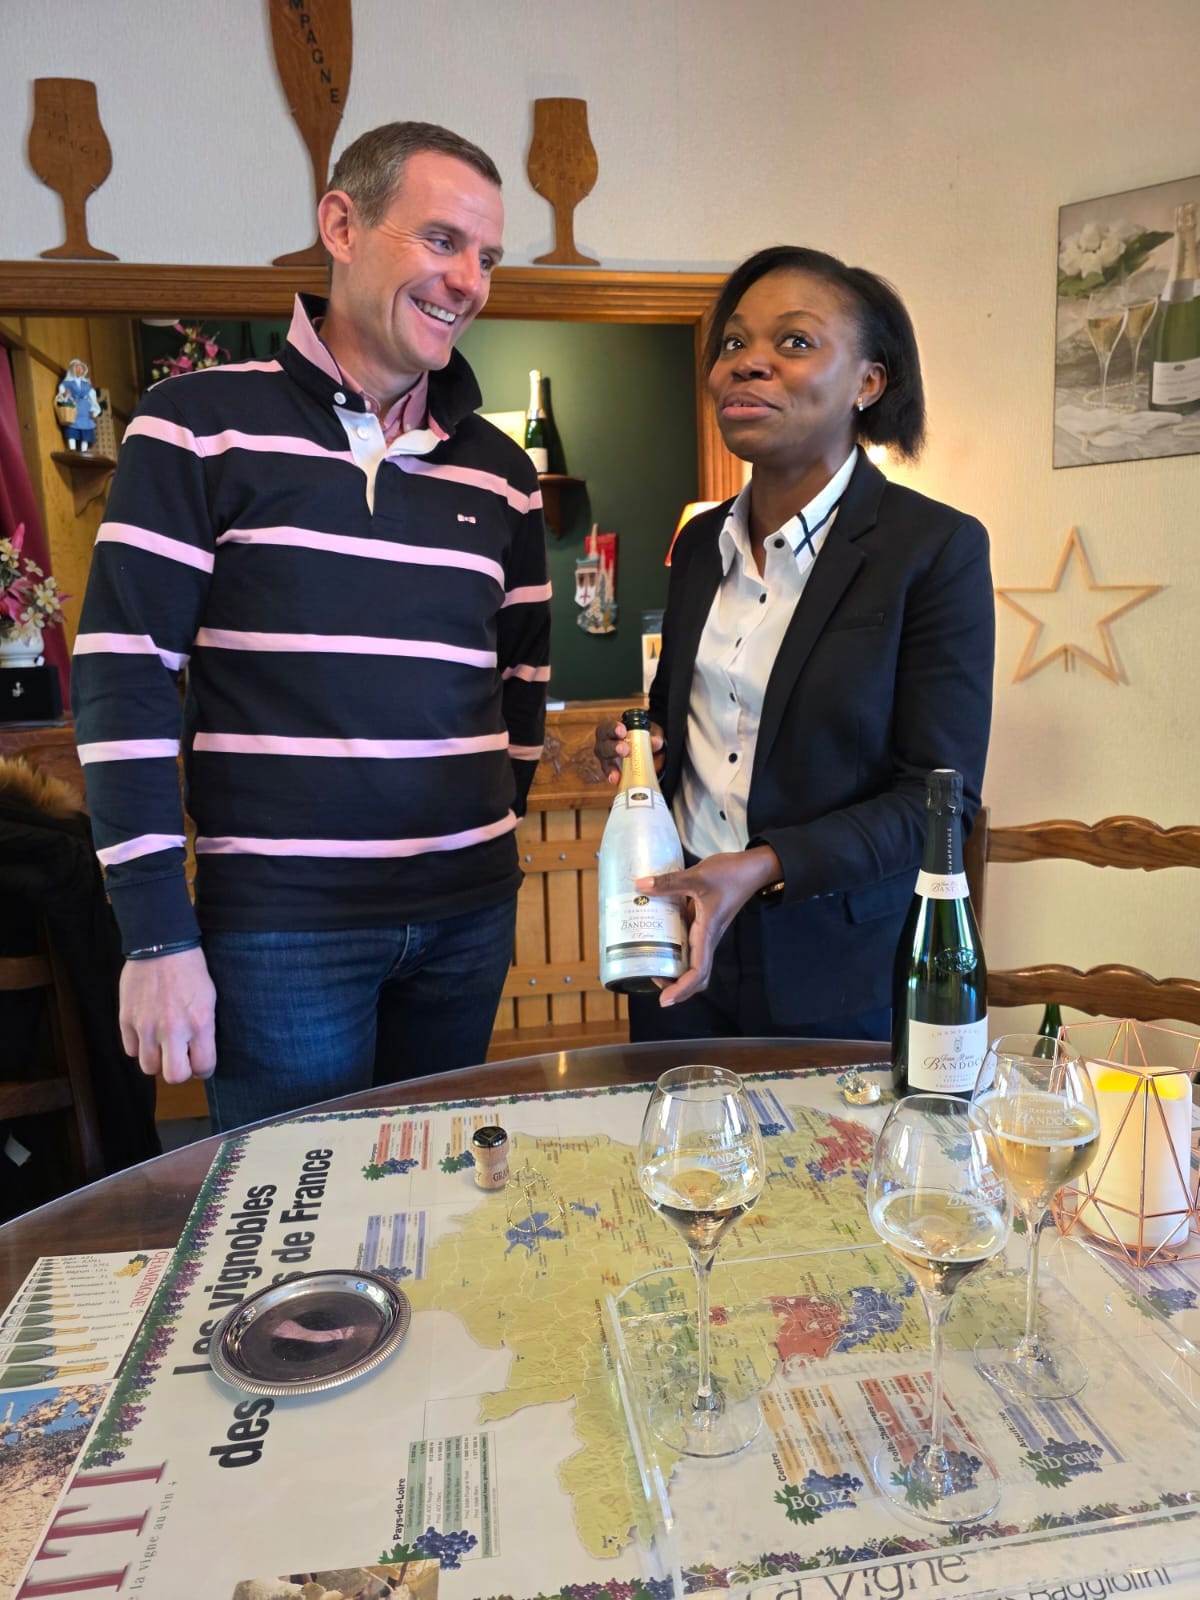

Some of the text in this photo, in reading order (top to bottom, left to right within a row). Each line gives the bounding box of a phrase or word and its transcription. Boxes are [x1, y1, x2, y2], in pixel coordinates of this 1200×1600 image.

[288, 0, 340, 104] MPAGNE
[620, 919, 664, 930] BANDOCK
[279, 1148, 333, 1224] France
[130, 1251, 170, 1308] CHAMPAGNE
[203, 1184, 277, 1310] vignobles
[270, 1230, 316, 1263] de
[208, 1397, 275, 1468] des
[771, 1453, 787, 1482] Centre
[139, 1536, 159, 1571] vigne
[153, 1515, 166, 1531] au
[160, 1493, 174, 1511] vin
[393, 1478, 405, 1540] Pays-de-Loire
